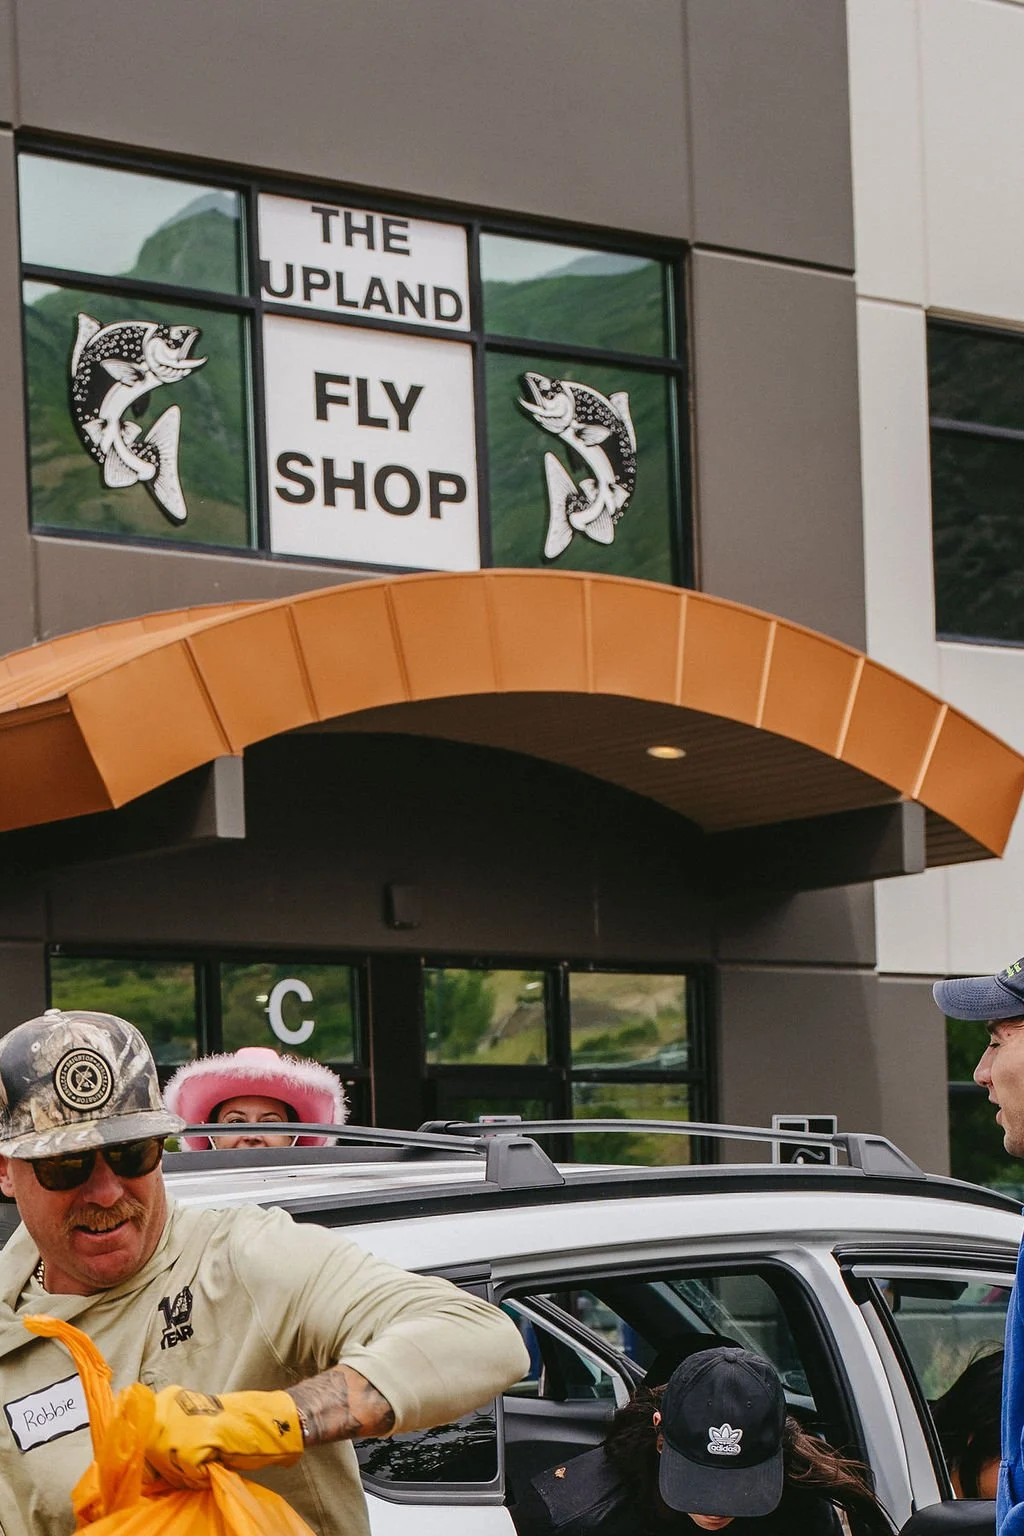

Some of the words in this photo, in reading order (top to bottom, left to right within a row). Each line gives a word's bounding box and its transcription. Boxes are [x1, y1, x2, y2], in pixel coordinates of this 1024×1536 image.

[311, 206, 410, 256] THE
[260, 260, 463, 323] UPLAND
[314, 372, 423, 432] FLY
[276, 451, 466, 520] SHOP
[268, 978, 315, 1046] C
[23, 1397, 78, 1432] Robbie
[710, 1443, 739, 1453] adidas
